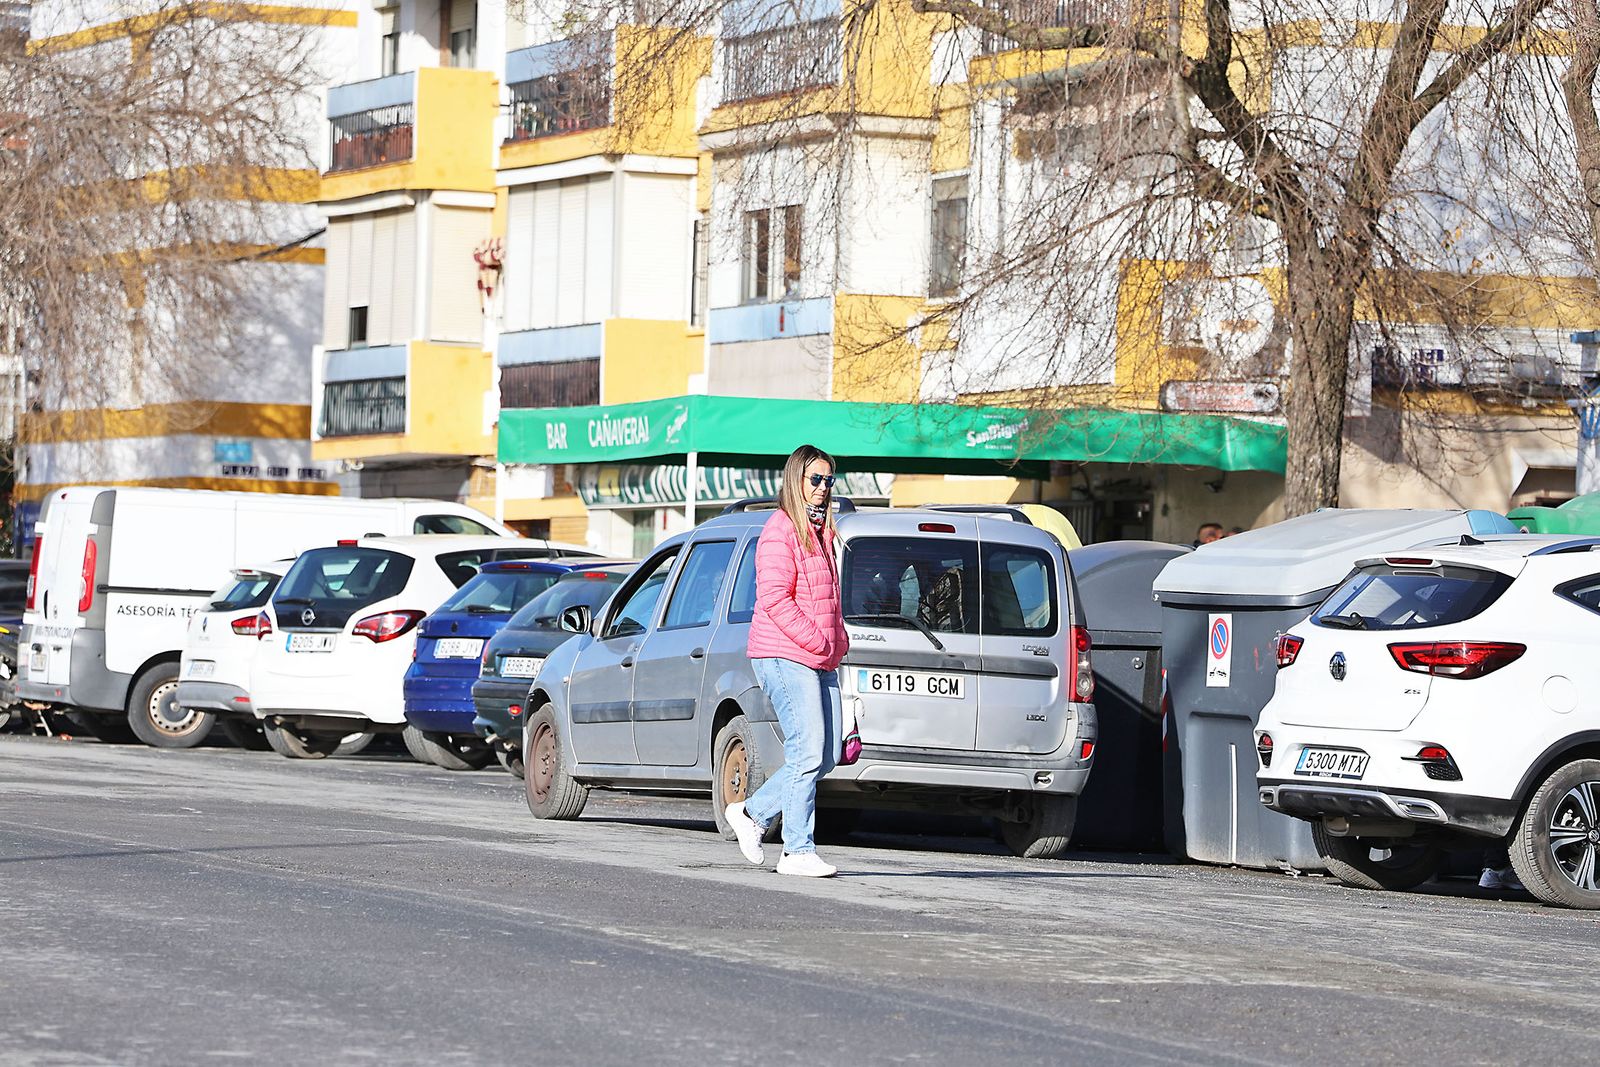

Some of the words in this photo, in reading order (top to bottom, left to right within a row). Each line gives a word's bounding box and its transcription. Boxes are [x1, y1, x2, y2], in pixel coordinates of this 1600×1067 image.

[546, 422, 568, 450] BAR
[588, 414, 650, 448] CAÑAVERAL
[117, 603, 176, 617] ASESORÍA
[852, 633, 887, 642] DACIA
[872, 673, 915, 692] 6119
[927, 677, 959, 696] GCM
[1306, 752, 1337, 769] 5300
[1337, 754, 1367, 773] MTX
